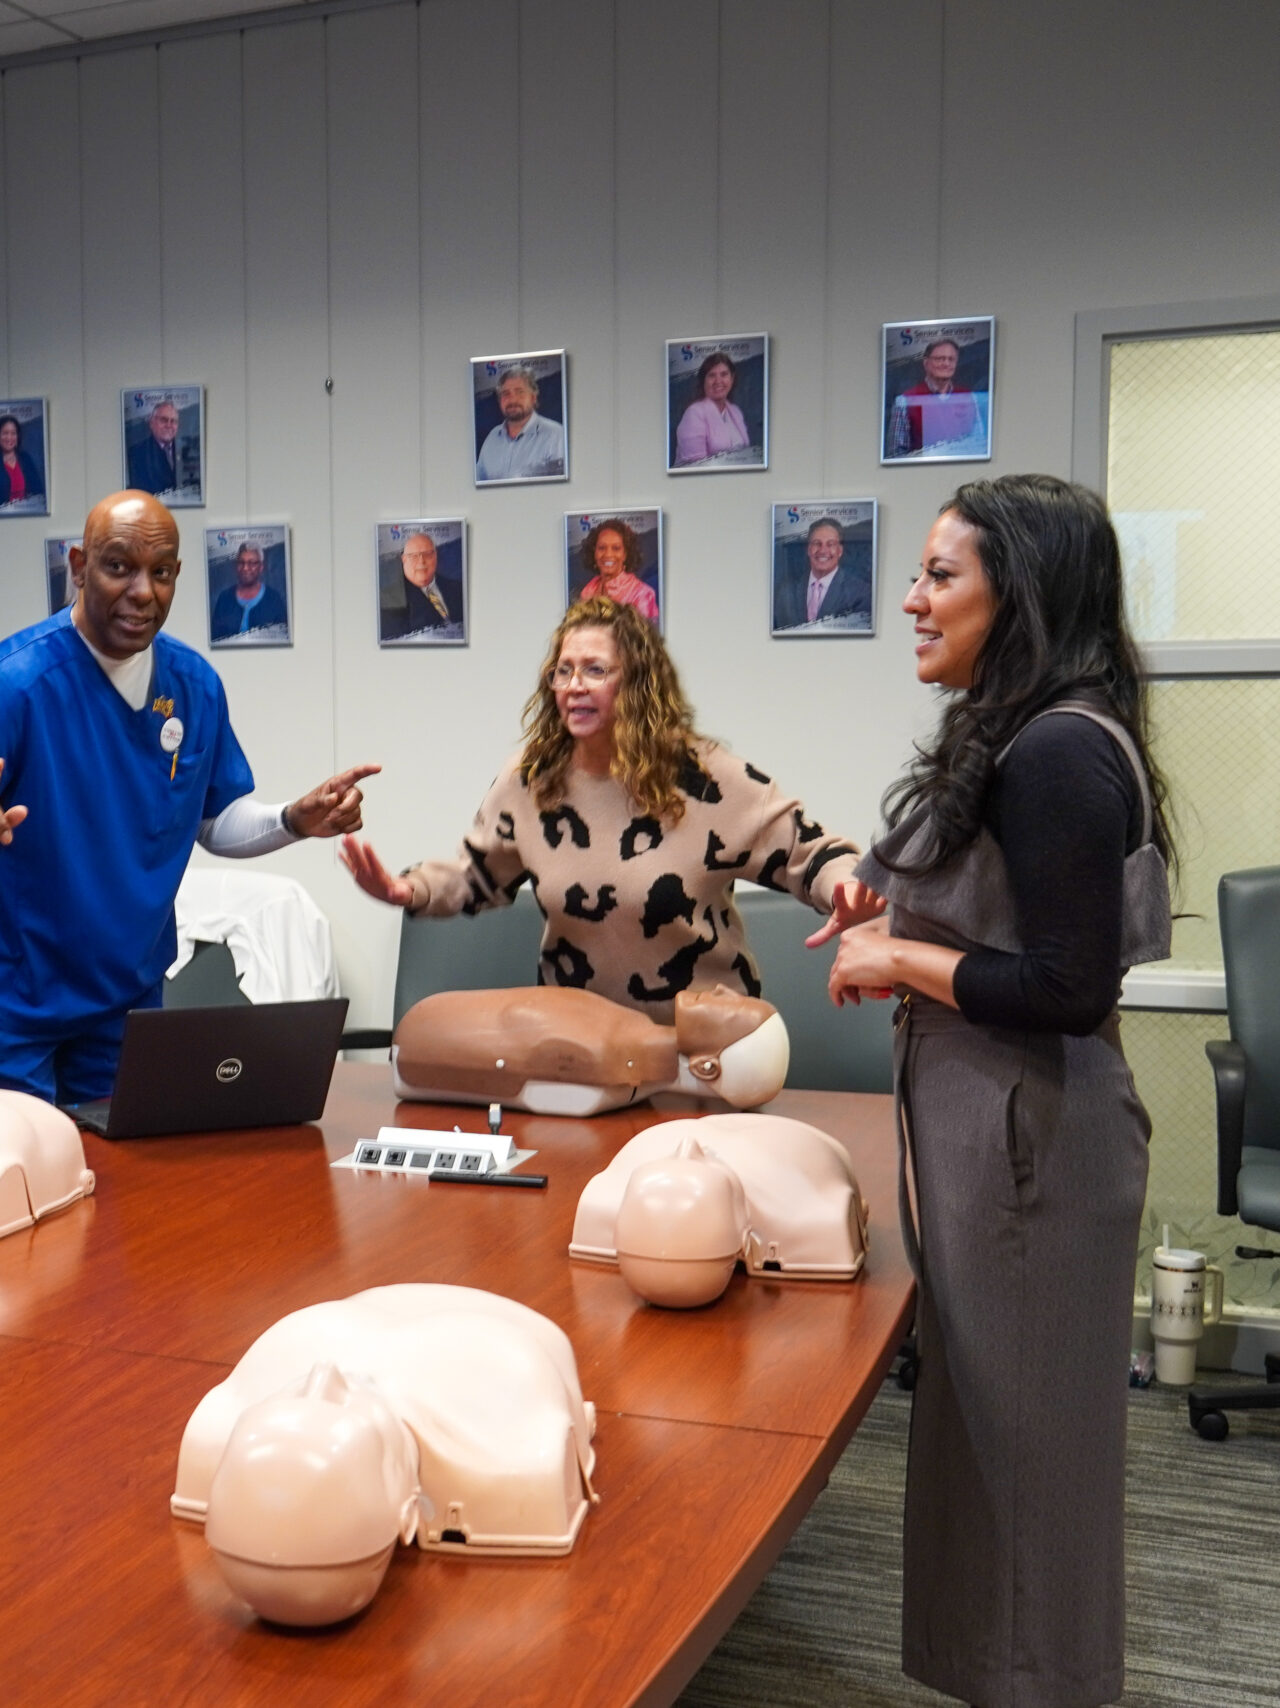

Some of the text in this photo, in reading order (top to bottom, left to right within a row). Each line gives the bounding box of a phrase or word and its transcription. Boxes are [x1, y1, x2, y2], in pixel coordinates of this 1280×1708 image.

[913, 327, 975, 337] Senior Services
[800, 506, 858, 517] Senior Services
